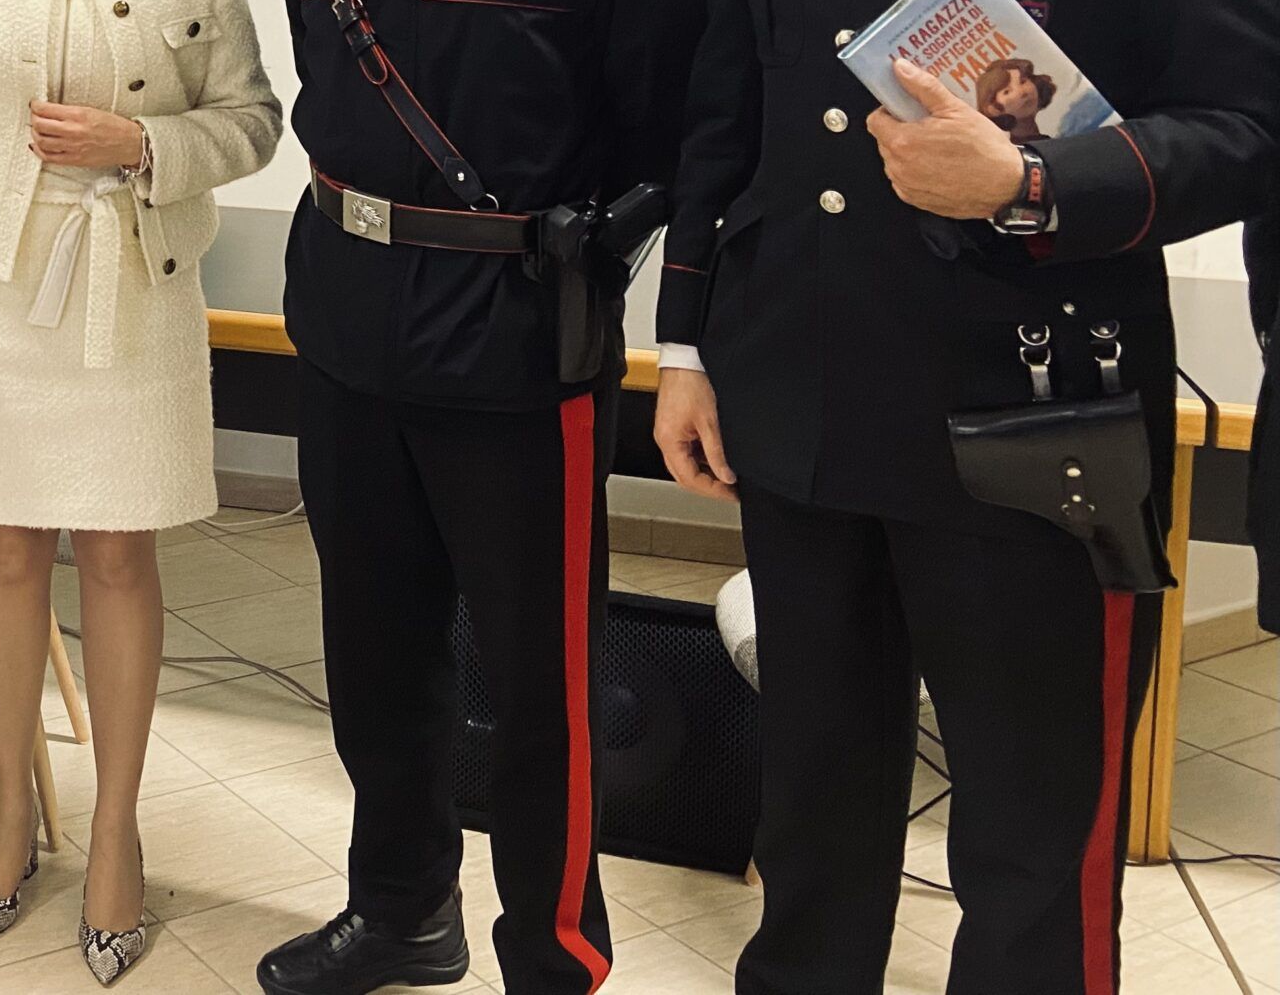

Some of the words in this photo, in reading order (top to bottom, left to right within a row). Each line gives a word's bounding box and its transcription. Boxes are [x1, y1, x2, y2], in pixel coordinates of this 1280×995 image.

[922, 16, 970, 59] SOGNAVA
[968, 4, 983, 19] DI
[926, 16, 997, 77] ONFIGGERE
[949, 30, 1017, 92] MAFIA
